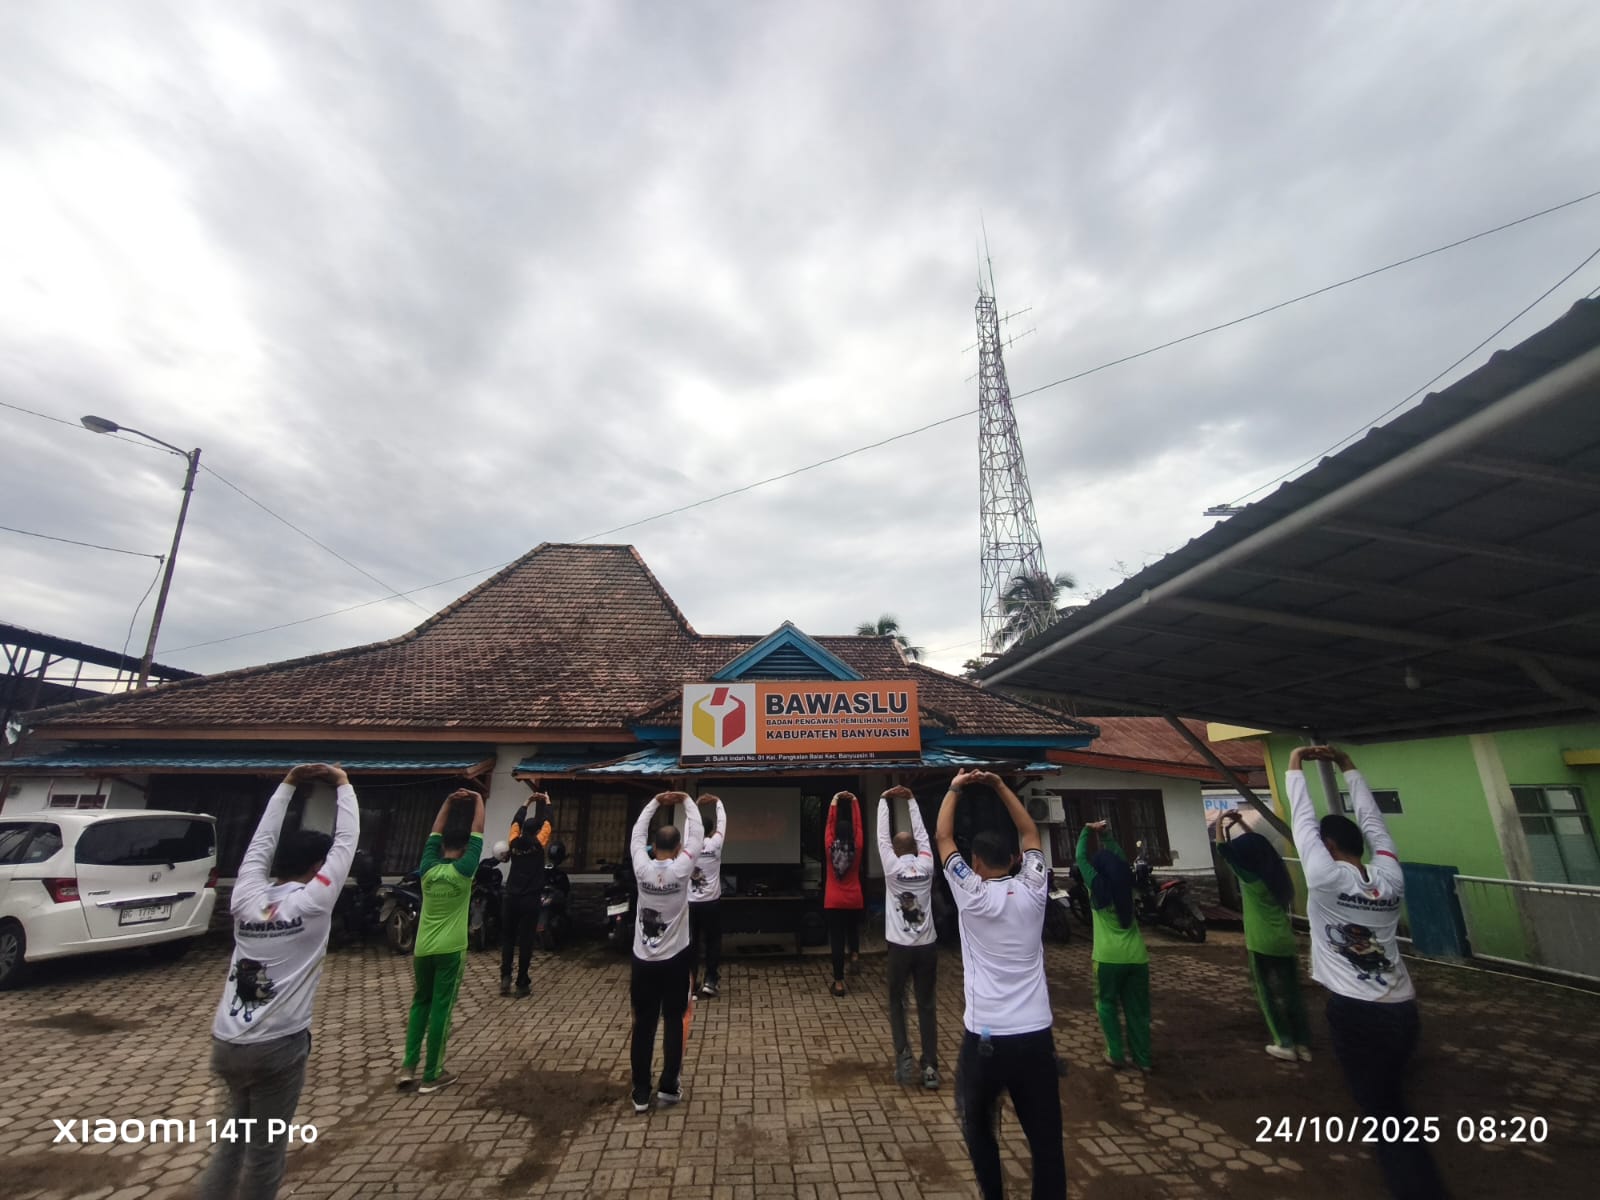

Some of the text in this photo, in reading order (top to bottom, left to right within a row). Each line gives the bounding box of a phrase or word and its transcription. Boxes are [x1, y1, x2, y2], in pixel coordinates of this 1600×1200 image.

[765, 692, 908, 716] BAWASLU
[766, 718, 793, 726] BADAN
[841, 717, 883, 725] PEMILIHAN
[766, 728, 909, 740] KABUPATEN BANYUASIN
[1205, 800, 1228, 809] PLN
